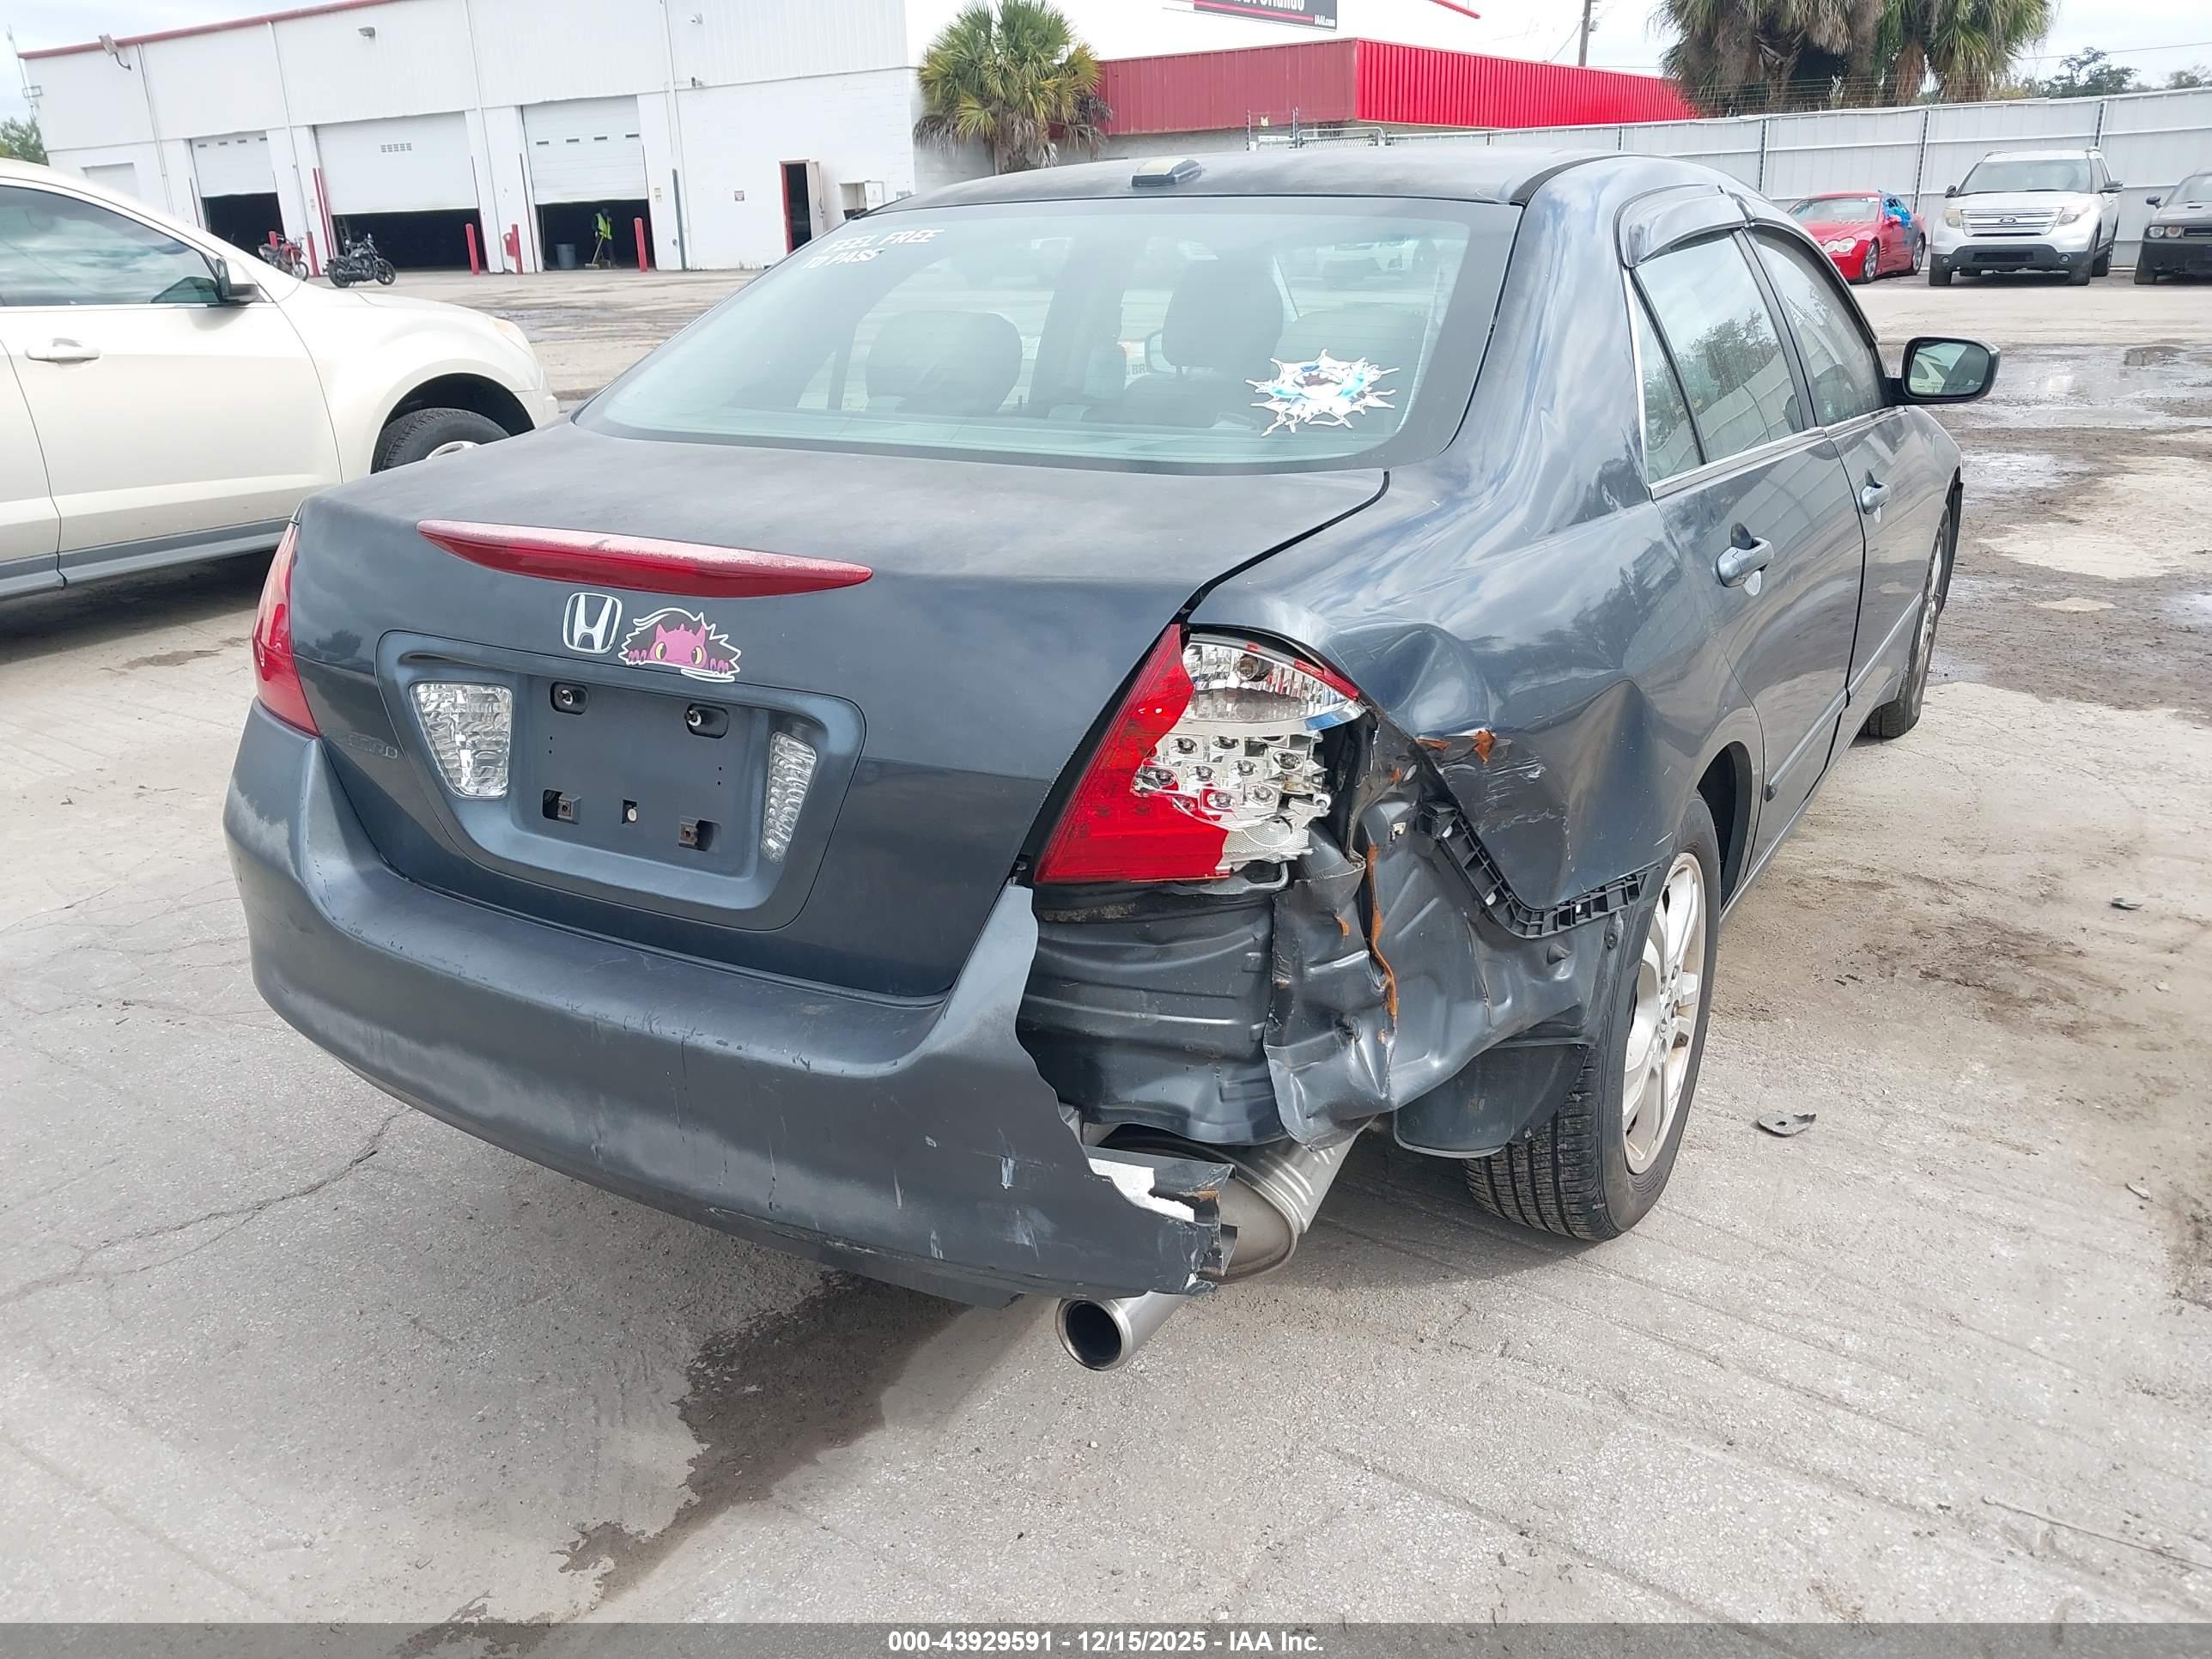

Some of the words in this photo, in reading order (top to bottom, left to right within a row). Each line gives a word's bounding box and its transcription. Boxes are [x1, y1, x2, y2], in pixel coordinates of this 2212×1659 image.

[822, 234, 878, 253] FEEL
[878, 229, 945, 246] FREE
[800, 255, 830, 270] TO
[825, 248, 885, 265] PASS
